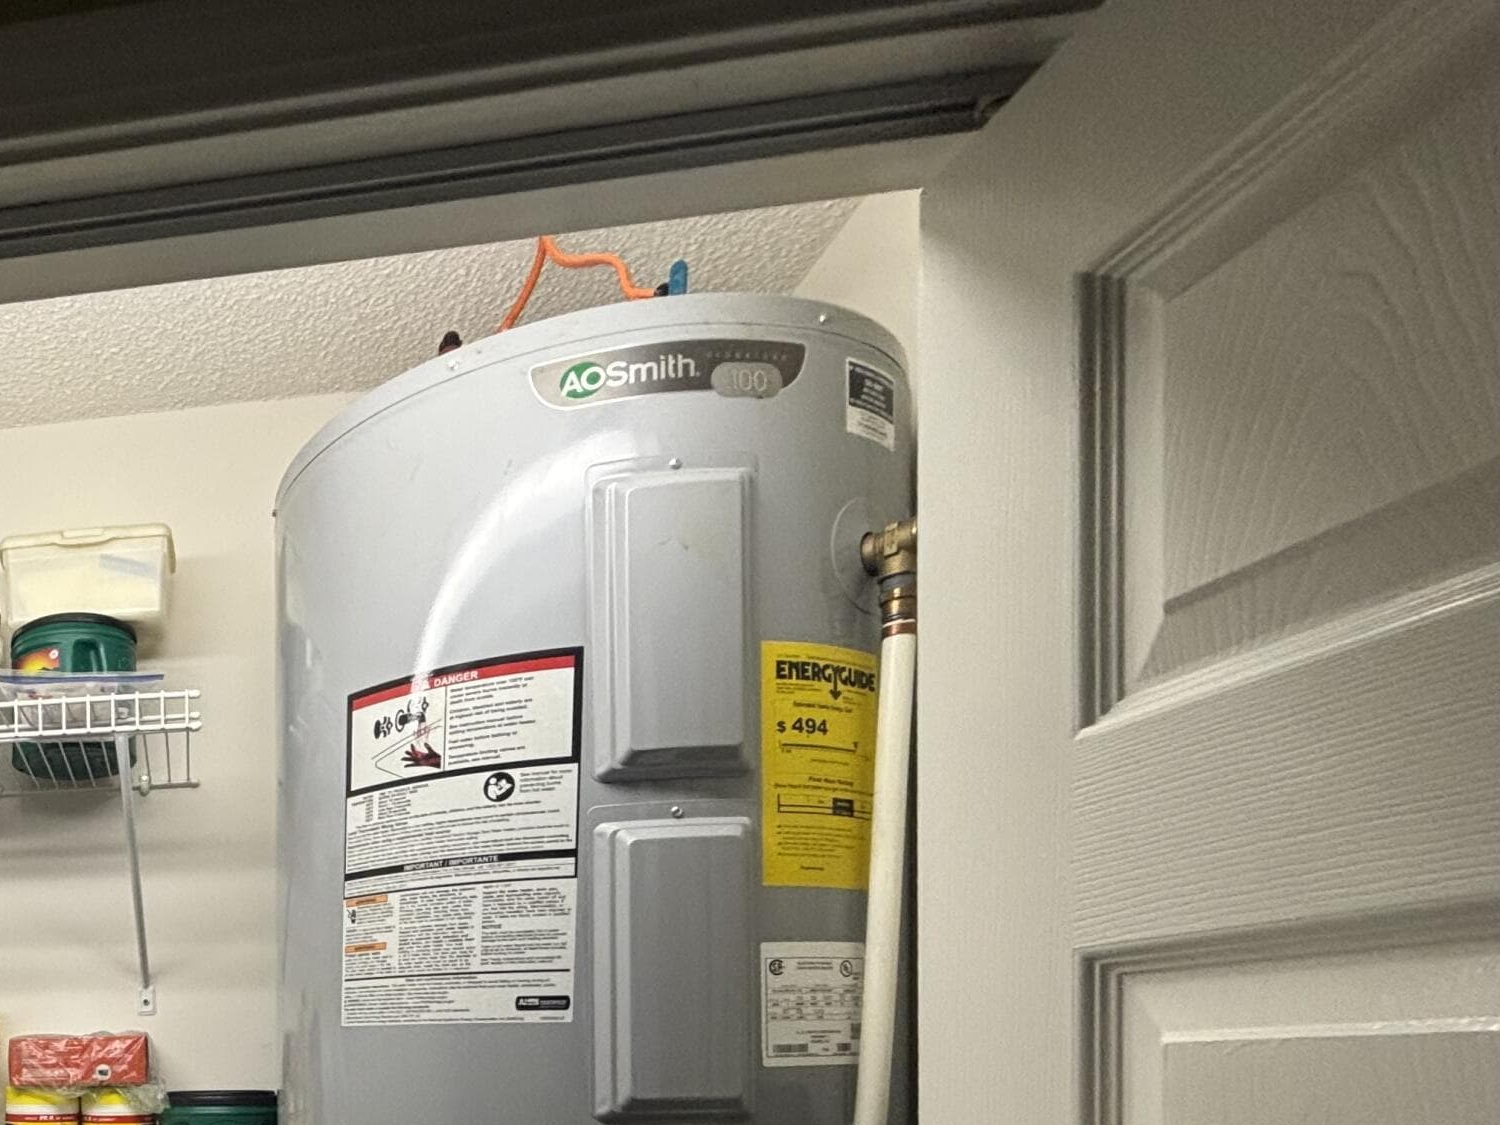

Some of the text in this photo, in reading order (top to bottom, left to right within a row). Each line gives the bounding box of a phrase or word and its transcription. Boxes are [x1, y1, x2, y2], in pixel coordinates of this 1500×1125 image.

[433, 671, 479, 688] DANGER
[777, 718, 828, 735] $ 494
[403, 860, 443, 871] IMPORTANT
